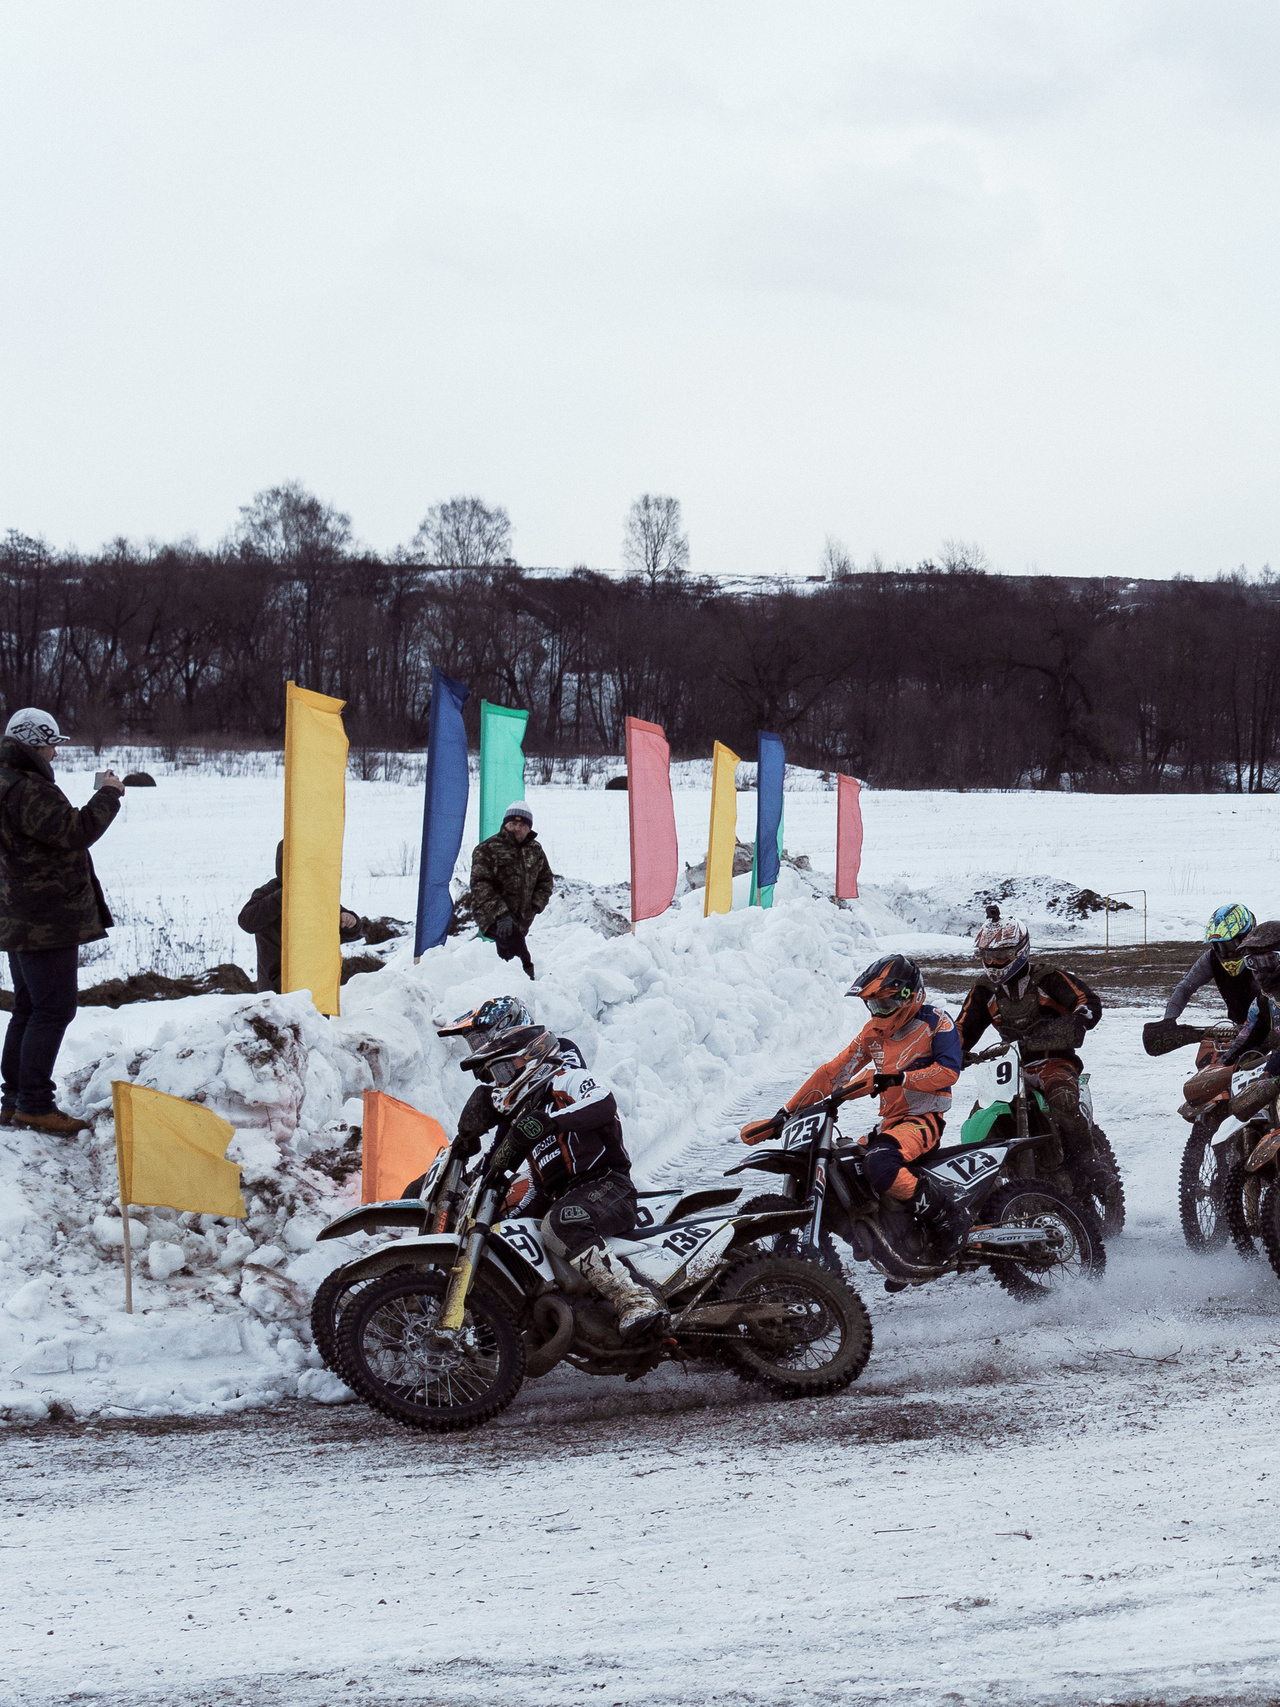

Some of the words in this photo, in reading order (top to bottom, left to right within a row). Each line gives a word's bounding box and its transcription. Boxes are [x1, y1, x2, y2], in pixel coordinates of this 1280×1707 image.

[995, 1061, 1012, 1085] 9
[784, 1116, 821, 1149] 123
[946, 1151, 998, 1182] 123
[662, 1225, 712, 1257] 136
